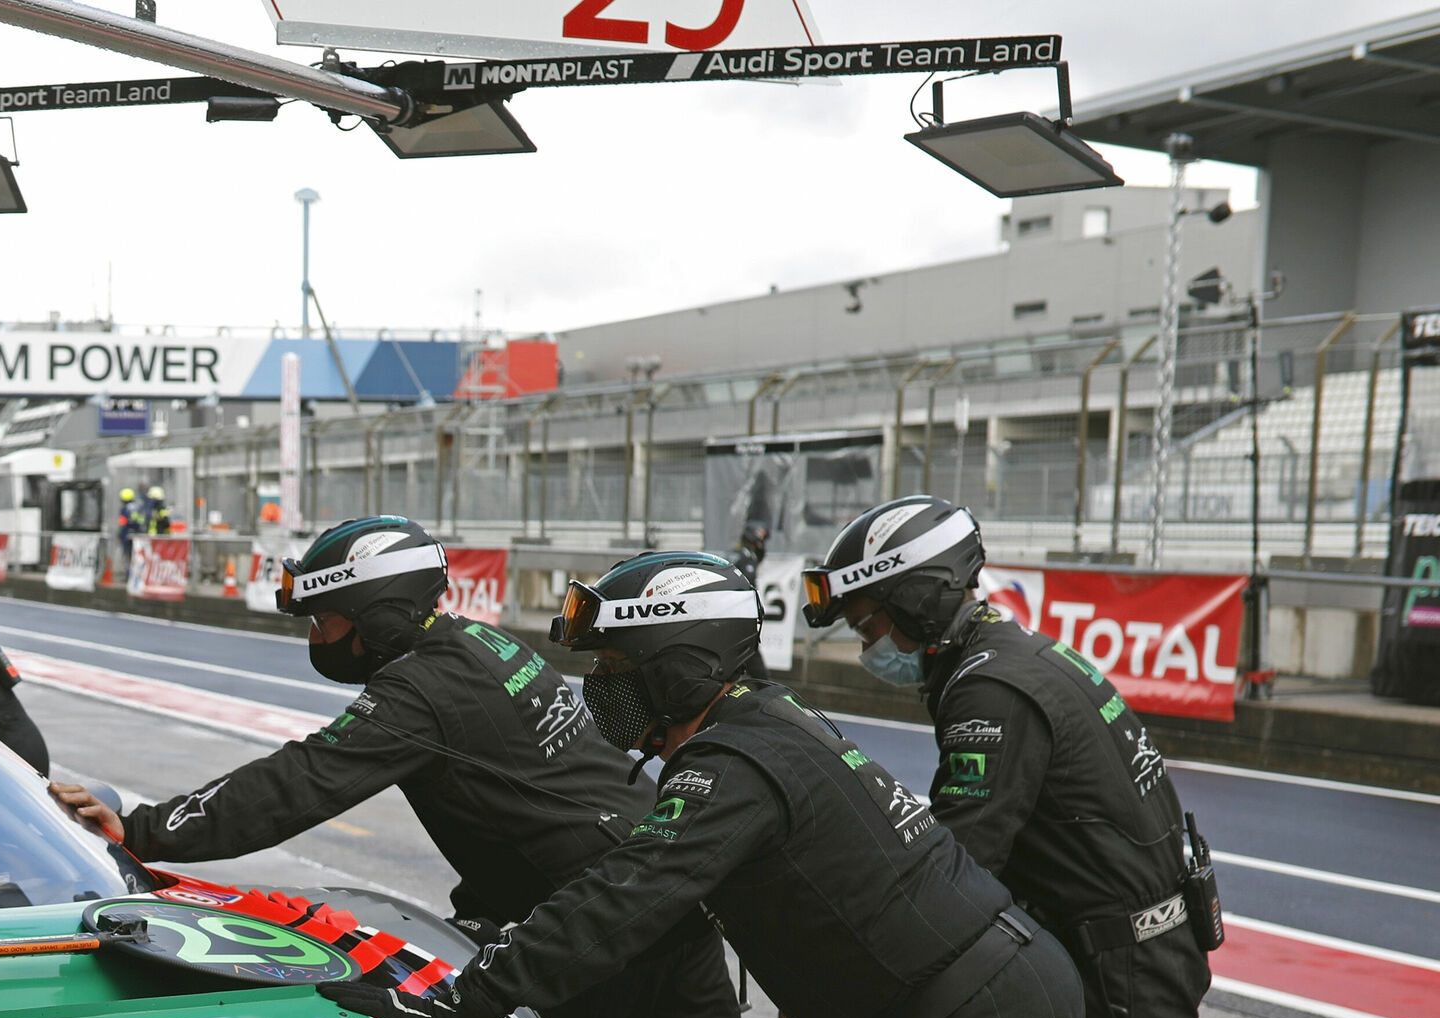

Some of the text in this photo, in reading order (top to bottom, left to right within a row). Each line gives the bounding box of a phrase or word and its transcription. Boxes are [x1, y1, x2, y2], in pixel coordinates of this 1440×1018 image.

[481, 59, 634, 84] MONTAPLAST
[705, 37, 1055, 78] Audi Sport Team Land
[51, 85, 110, 105] Team
[116, 81, 171, 102] Land
[49, 345, 220, 382] POWER
[303, 567, 357, 591] uvex
[842, 552, 906, 585] uvex
[441, 576, 503, 614] OTAL
[615, 600, 688, 620] uvex
[1049, 600, 1237, 683] TOTAL
[975, 725, 1002, 733] Land
[683, 773, 713, 786] Land
[142, 916, 331, 965] 29
